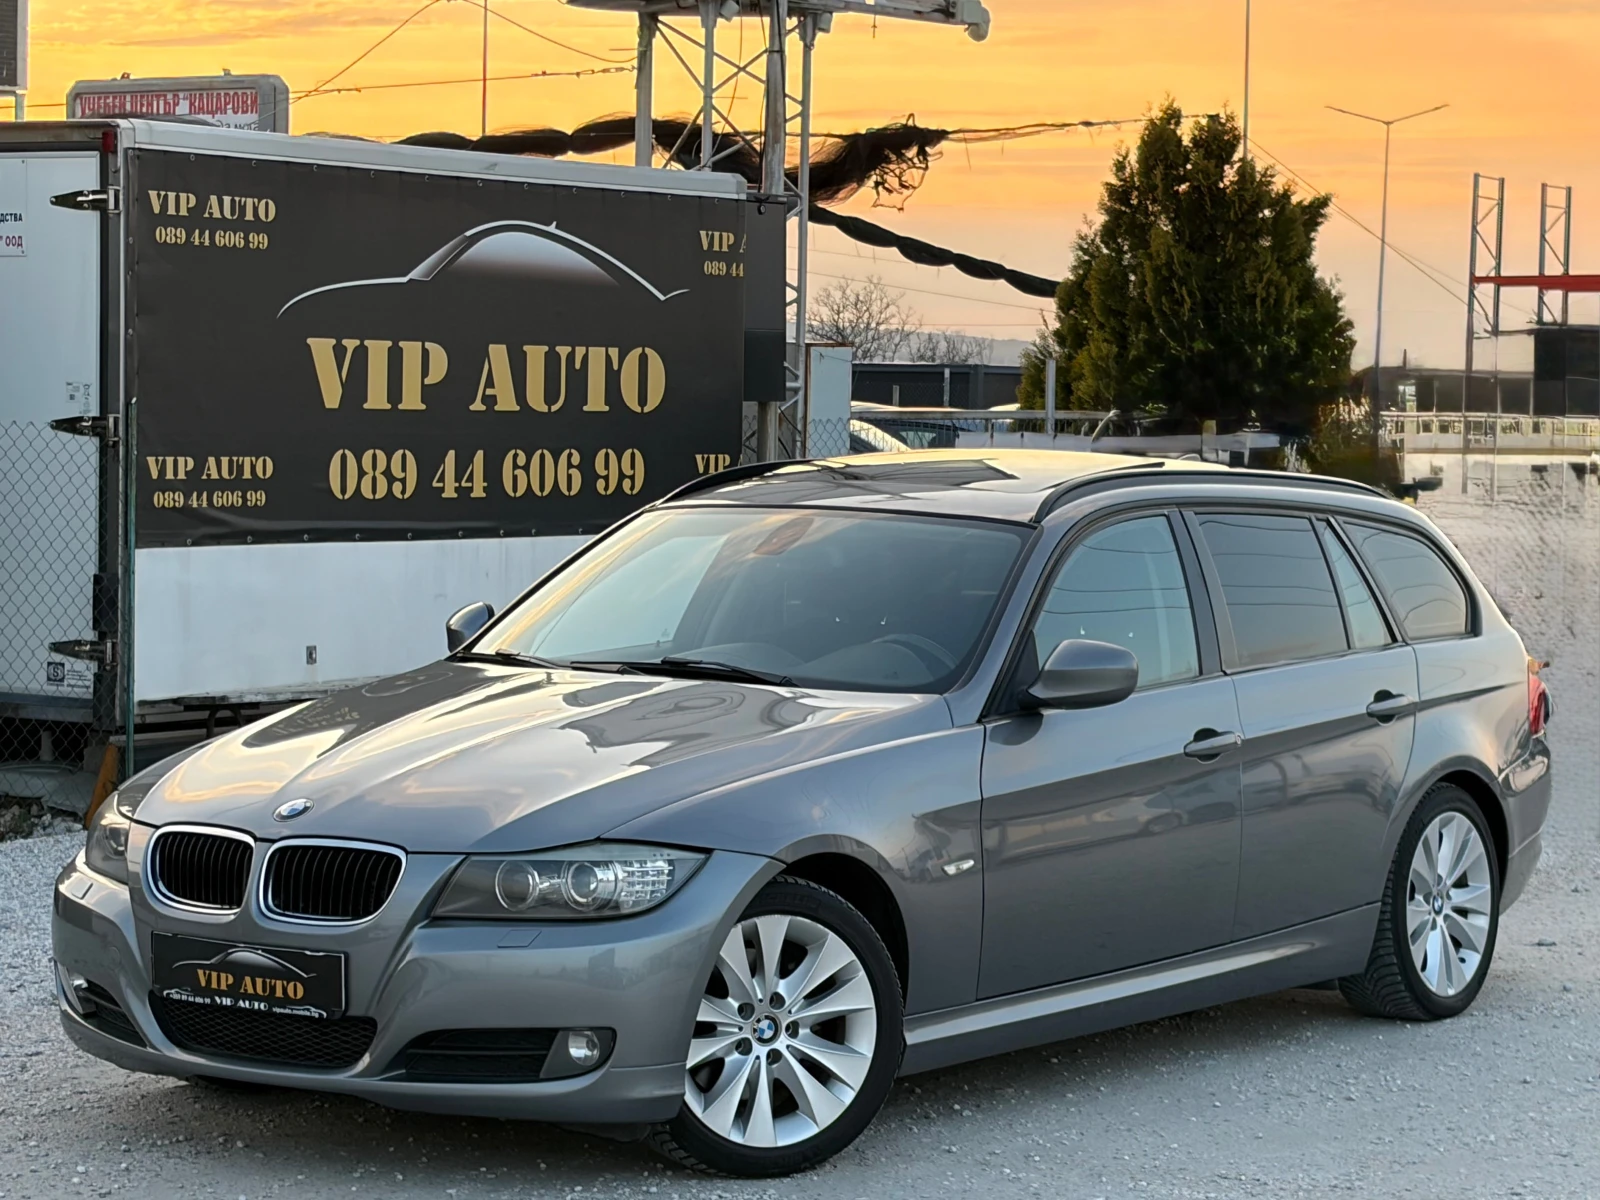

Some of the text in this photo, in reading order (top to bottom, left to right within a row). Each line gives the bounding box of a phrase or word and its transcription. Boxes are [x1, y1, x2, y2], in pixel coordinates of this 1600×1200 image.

[147, 189, 277, 223] VIP AUTO
[155, 225, 269, 250] 089 44 606 99
[699, 230, 735, 252] VIP
[703, 260, 744, 277] 089 44
[306, 337, 666, 414] VIP AUTO
[145, 455, 274, 480] VIP AUTO
[328, 447, 646, 501] 089 44 606 99
[694, 453, 731, 475] VIP
[153, 489, 266, 508] 089 44 606 99
[196, 968, 304, 1000] VIP AUTO
[214, 996, 269, 1011] VIP AUTO
